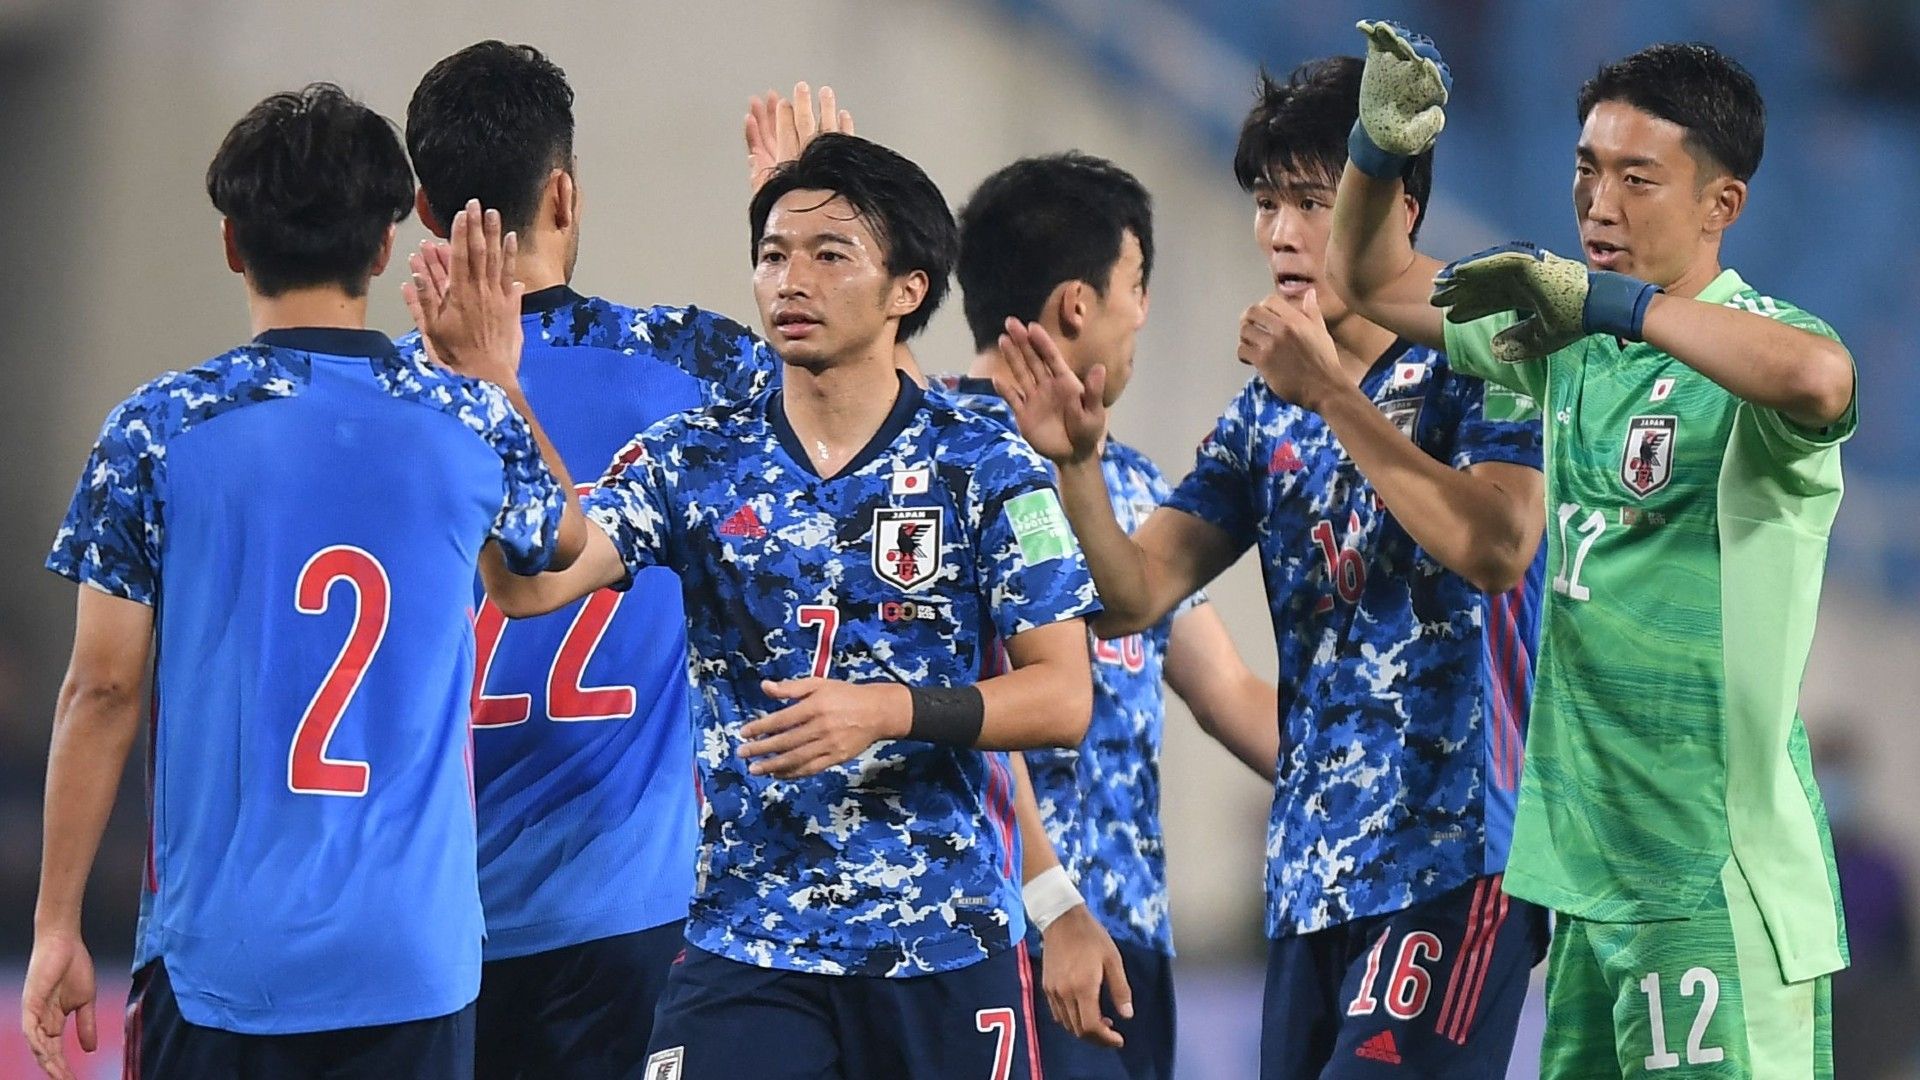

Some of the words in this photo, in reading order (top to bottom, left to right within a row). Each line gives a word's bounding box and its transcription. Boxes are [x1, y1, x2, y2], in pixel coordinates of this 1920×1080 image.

[1640, 419, 1666, 427] JAPAN
[1633, 471, 1655, 483] JFA
[892, 511, 926, 519] JAPAN
[1553, 502, 1607, 601] 12
[892, 564, 921, 576] JFA
[288, 544, 391, 797] 2
[797, 605, 840, 678] 7
[1347, 925, 1443, 1020] 16
[975, 1007, 1016, 1080] 7
[1640, 966, 1724, 1070] 12
